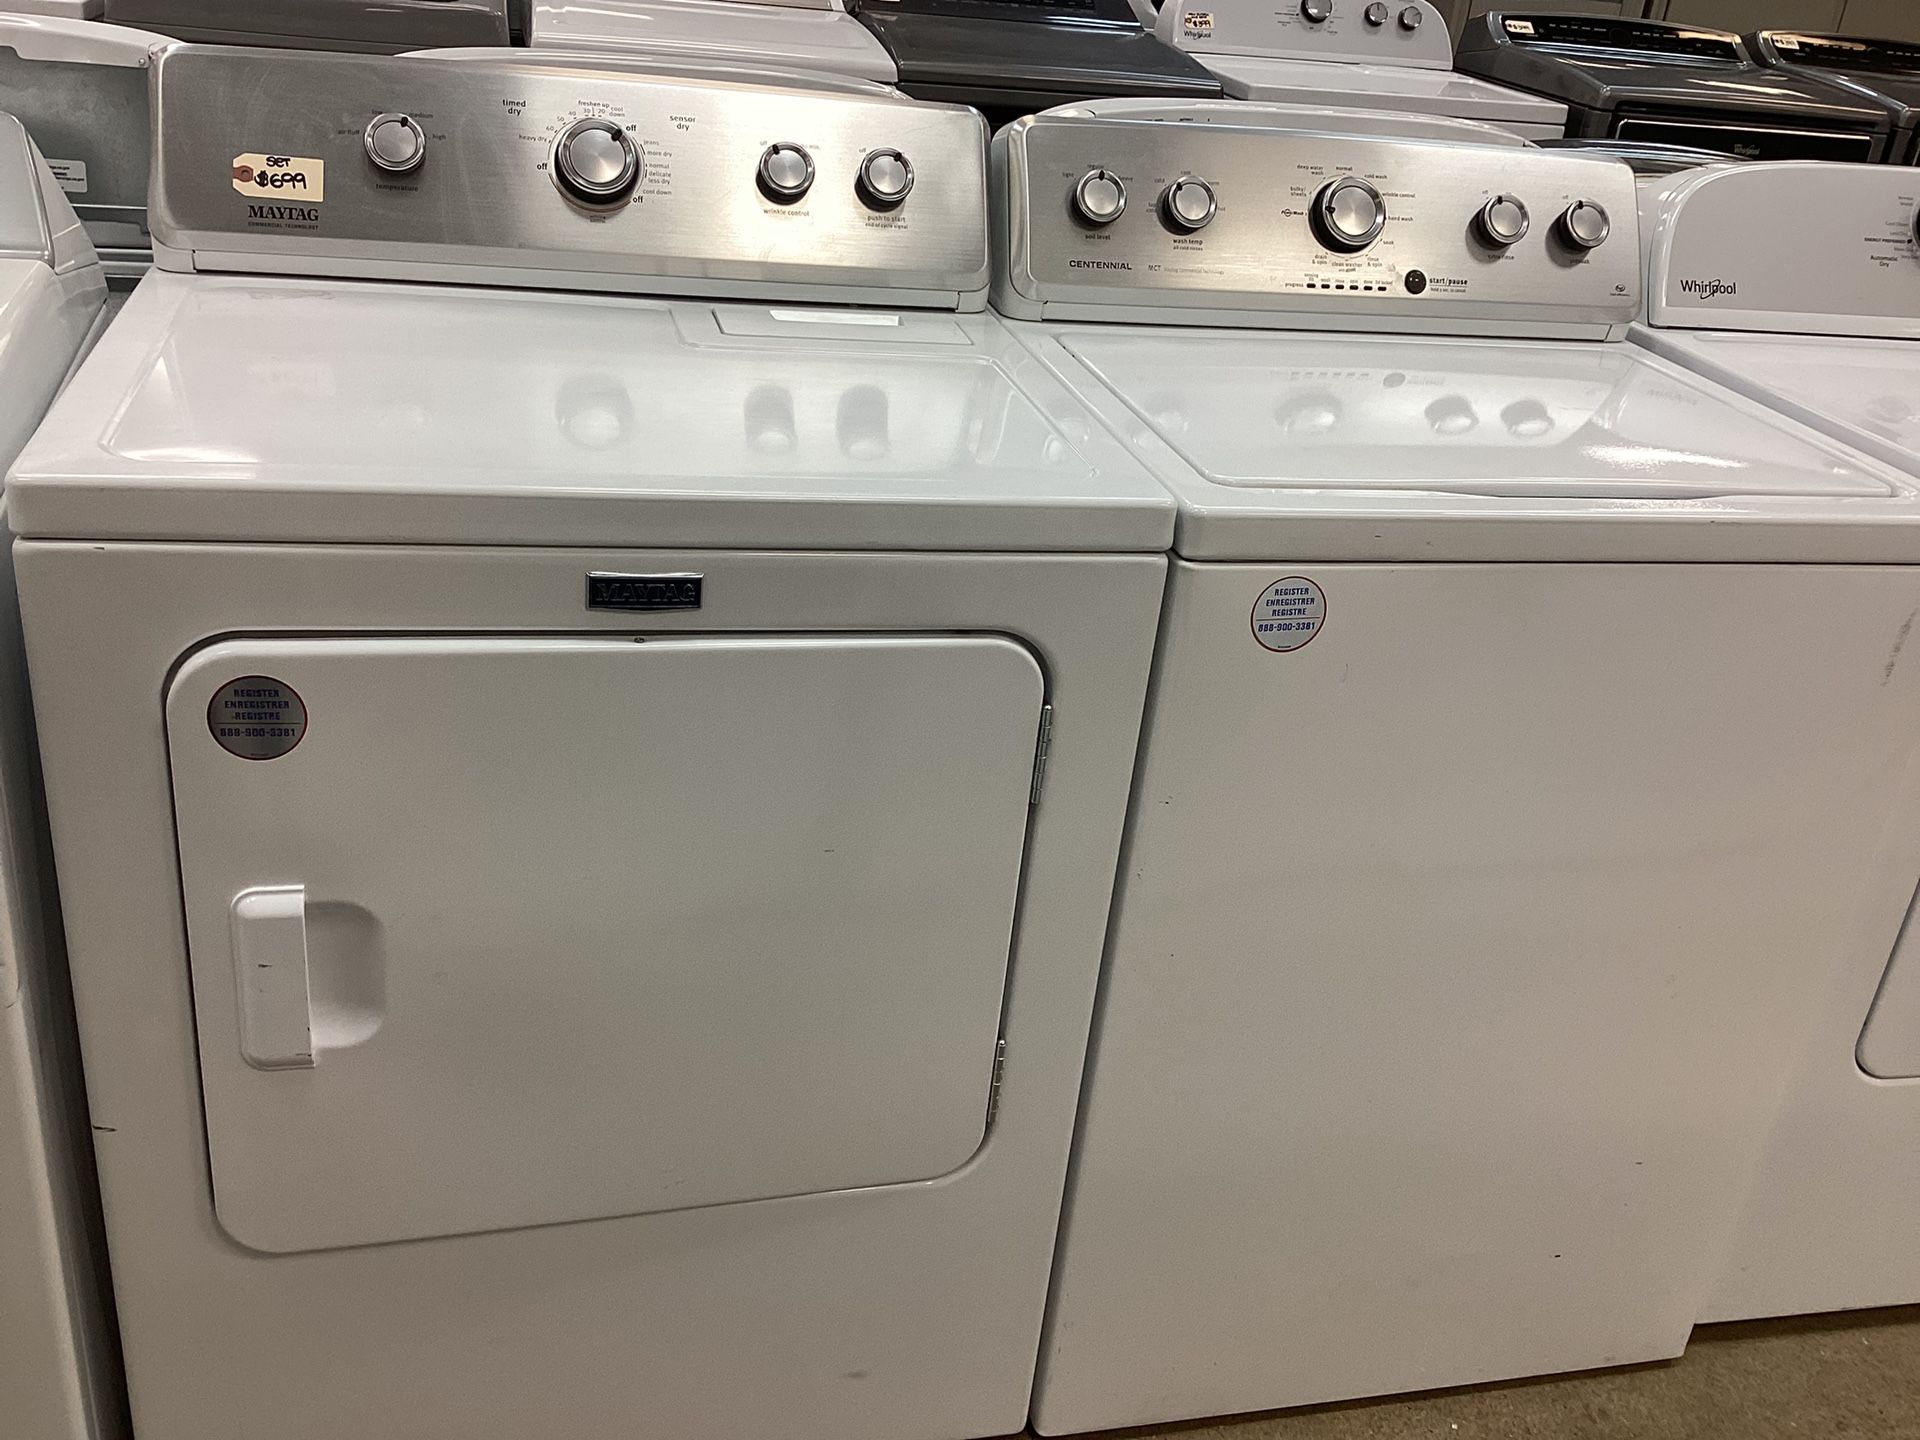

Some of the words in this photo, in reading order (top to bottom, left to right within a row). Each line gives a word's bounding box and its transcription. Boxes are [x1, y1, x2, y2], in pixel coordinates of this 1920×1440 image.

[502, 99, 526, 107] timed
[508, 106, 522, 116] dry
[669, 115, 696, 123] sensor
[625, 124, 637, 132] off
[676, 123, 690, 132] dry
[536, 163, 548, 171] off
[254, 170, 307, 189] $699
[376, 184, 418, 192] temperature
[248, 204, 319, 222] MAYTAG
[867, 215, 882, 223] push
[248, 221, 283, 229] COMMERCIAL
[284, 223, 319, 231] TECHNOLOGY
[1188, 239, 1204, 247] temp
[1069, 259, 1133, 271] CENTENNIAL
[1148, 264, 1162, 272] MCT
[1429, 277, 1468, 287] start/pause
[1680, 279, 1737, 300] Whirlpool
[596, 583, 696, 602] MAYTAG
[1274, 587, 1310, 597] REGISTER
[1265, 597, 1316, 607] ENREGISTRER
[1271, 608, 1307, 617] REGISTRE
[1257, 622, 1316, 633] 888-900-3381
[233, 689, 280, 698] REGISTER
[224, 700, 290, 709] ENREGISTRER
[234, 711, 281, 721] REGISTRE
[220, 728, 296, 737] 888-900-3381
